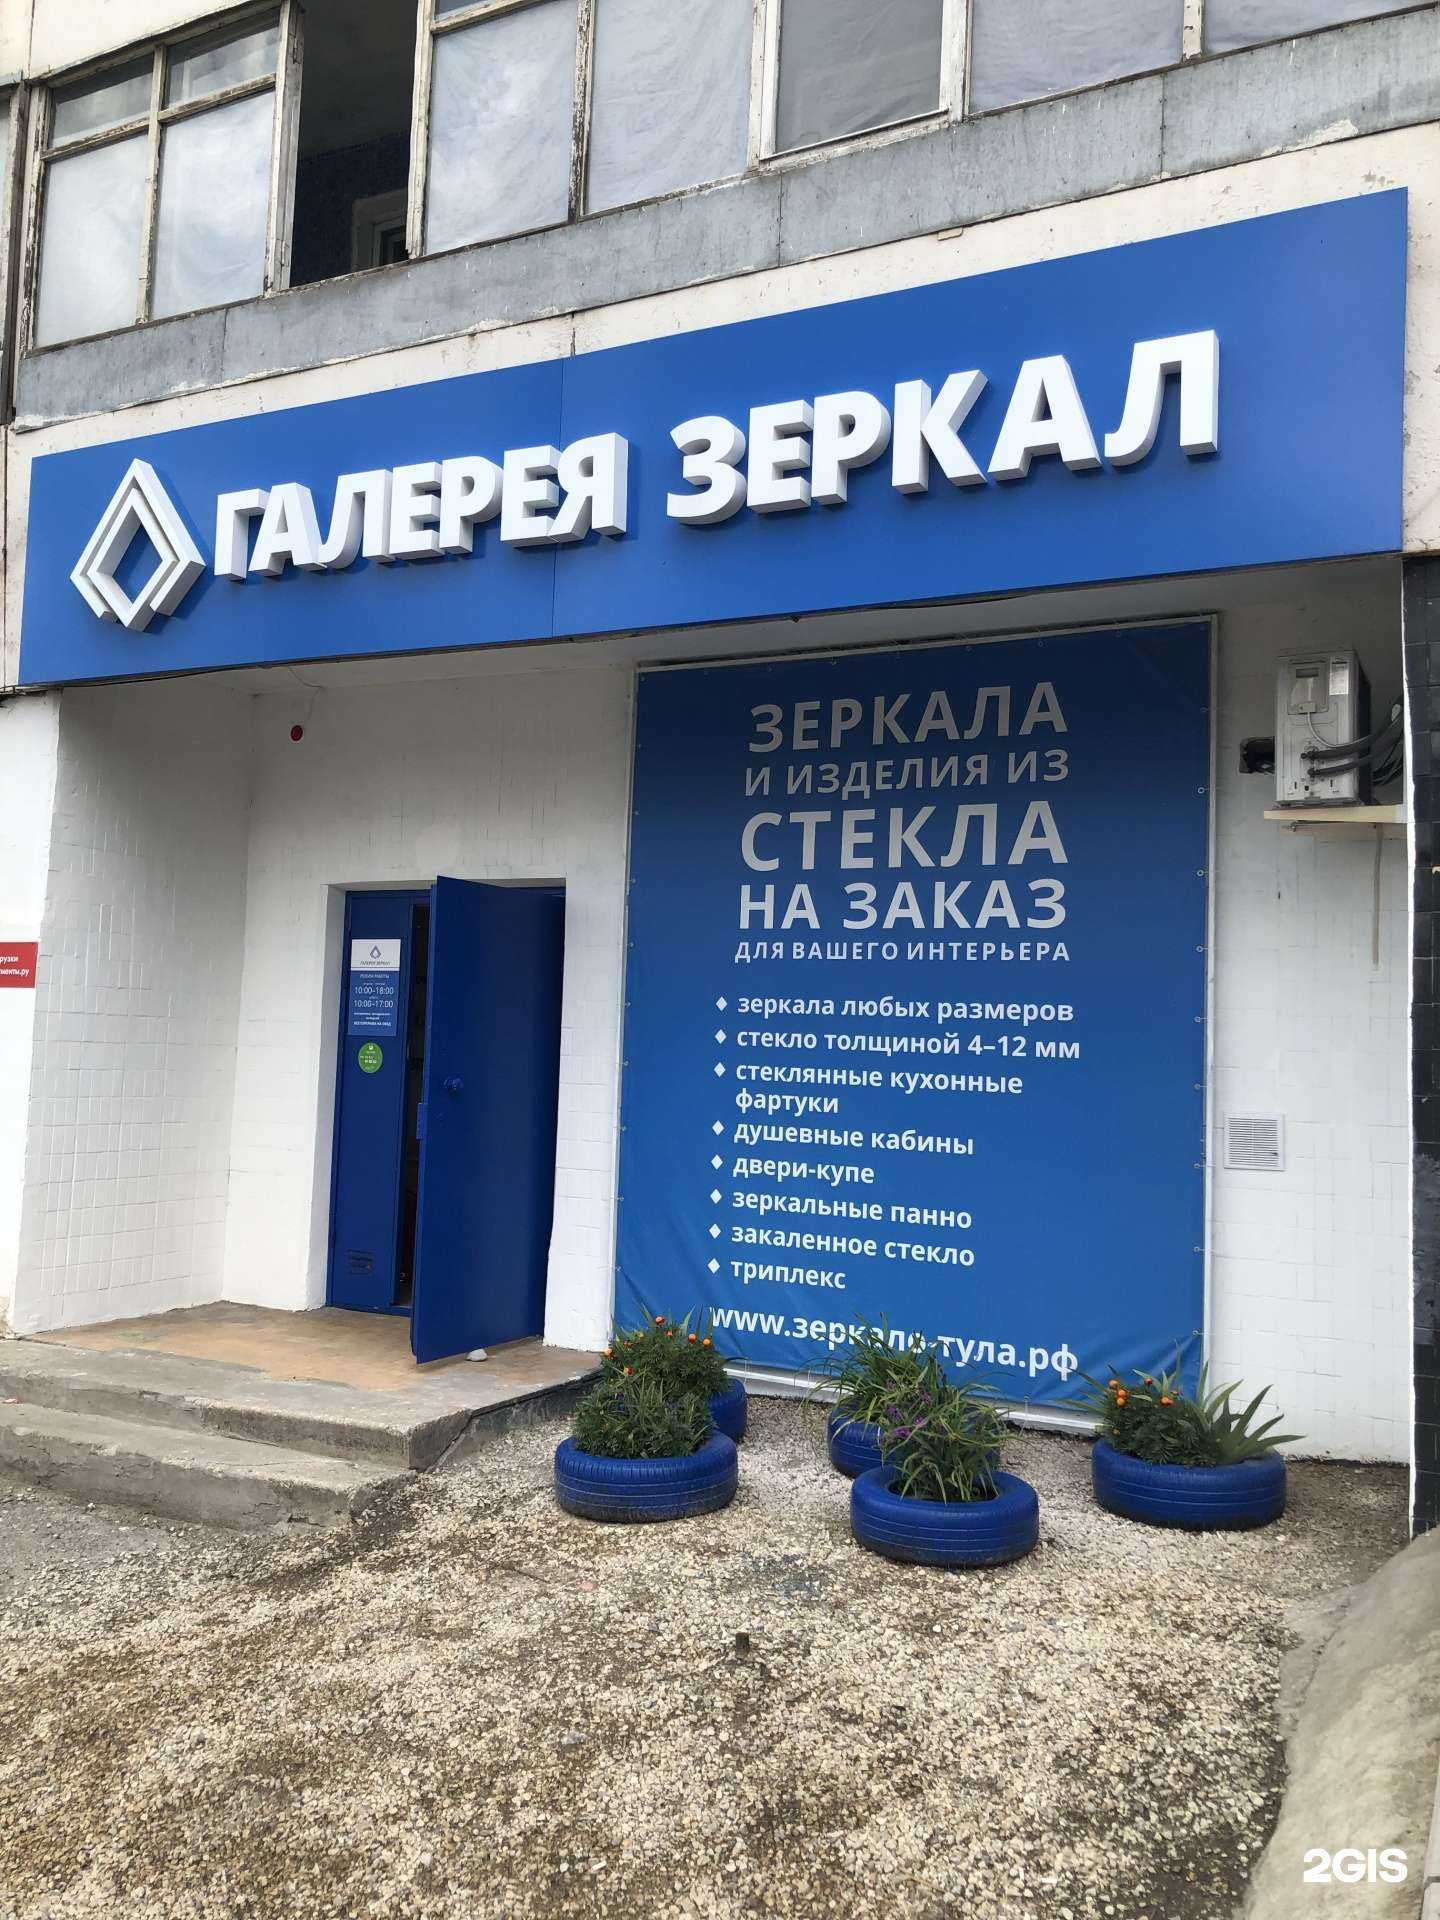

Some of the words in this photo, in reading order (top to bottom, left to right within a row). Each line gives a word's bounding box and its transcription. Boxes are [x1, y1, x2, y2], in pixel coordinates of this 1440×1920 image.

[214, 432, 628, 581] ГАЛЕРЕЯ
[667, 330, 1219, 525] ЗЕРКАЛ
[748, 681, 1068, 753] ЗЕРКАЛА
[745, 766, 771, 797] И
[786, 753, 990, 801] ИЗДЕЛИЯ
[1007, 749, 1070, 784] ИЗ
[741, 799, 1069, 872] СТЕКЛА
[739, 883, 821, 930] НА
[842, 878, 1067, 930] ЗАКАЗ
[734, 941, 785, 964] ДЛЯ
[792, 942, 899, 961] ВАШЕГО
[907, 942, 1071, 961] ИНТЕРЬЕРА
[737, 997, 834, 1019] зеркала
[841, 996, 930, 1018] любых
[937, 1000, 1075, 1026] размеров
[736, 1030, 817, 1050] стекло
[824, 1032, 960, 1057] толщиной
[1035, 1040, 1080, 1059] мм
[736, 1061, 882, 1087] стеклянные
[890, 1070, 1023, 1094] кухонные
[735, 1088, 839, 1117] фартуки
[733, 1122, 864, 1148] душевные
[871, 1130, 974, 1155] кабины
[732, 1156, 875, 1187] двери-купе
[732, 1191, 883, 1221] зеркальные
[890, 1205, 972, 1229] панно
[731, 1226, 877, 1257] закаленное
[884, 1240, 976, 1267] стекло
[730, 1259, 847, 1290] триплекс
